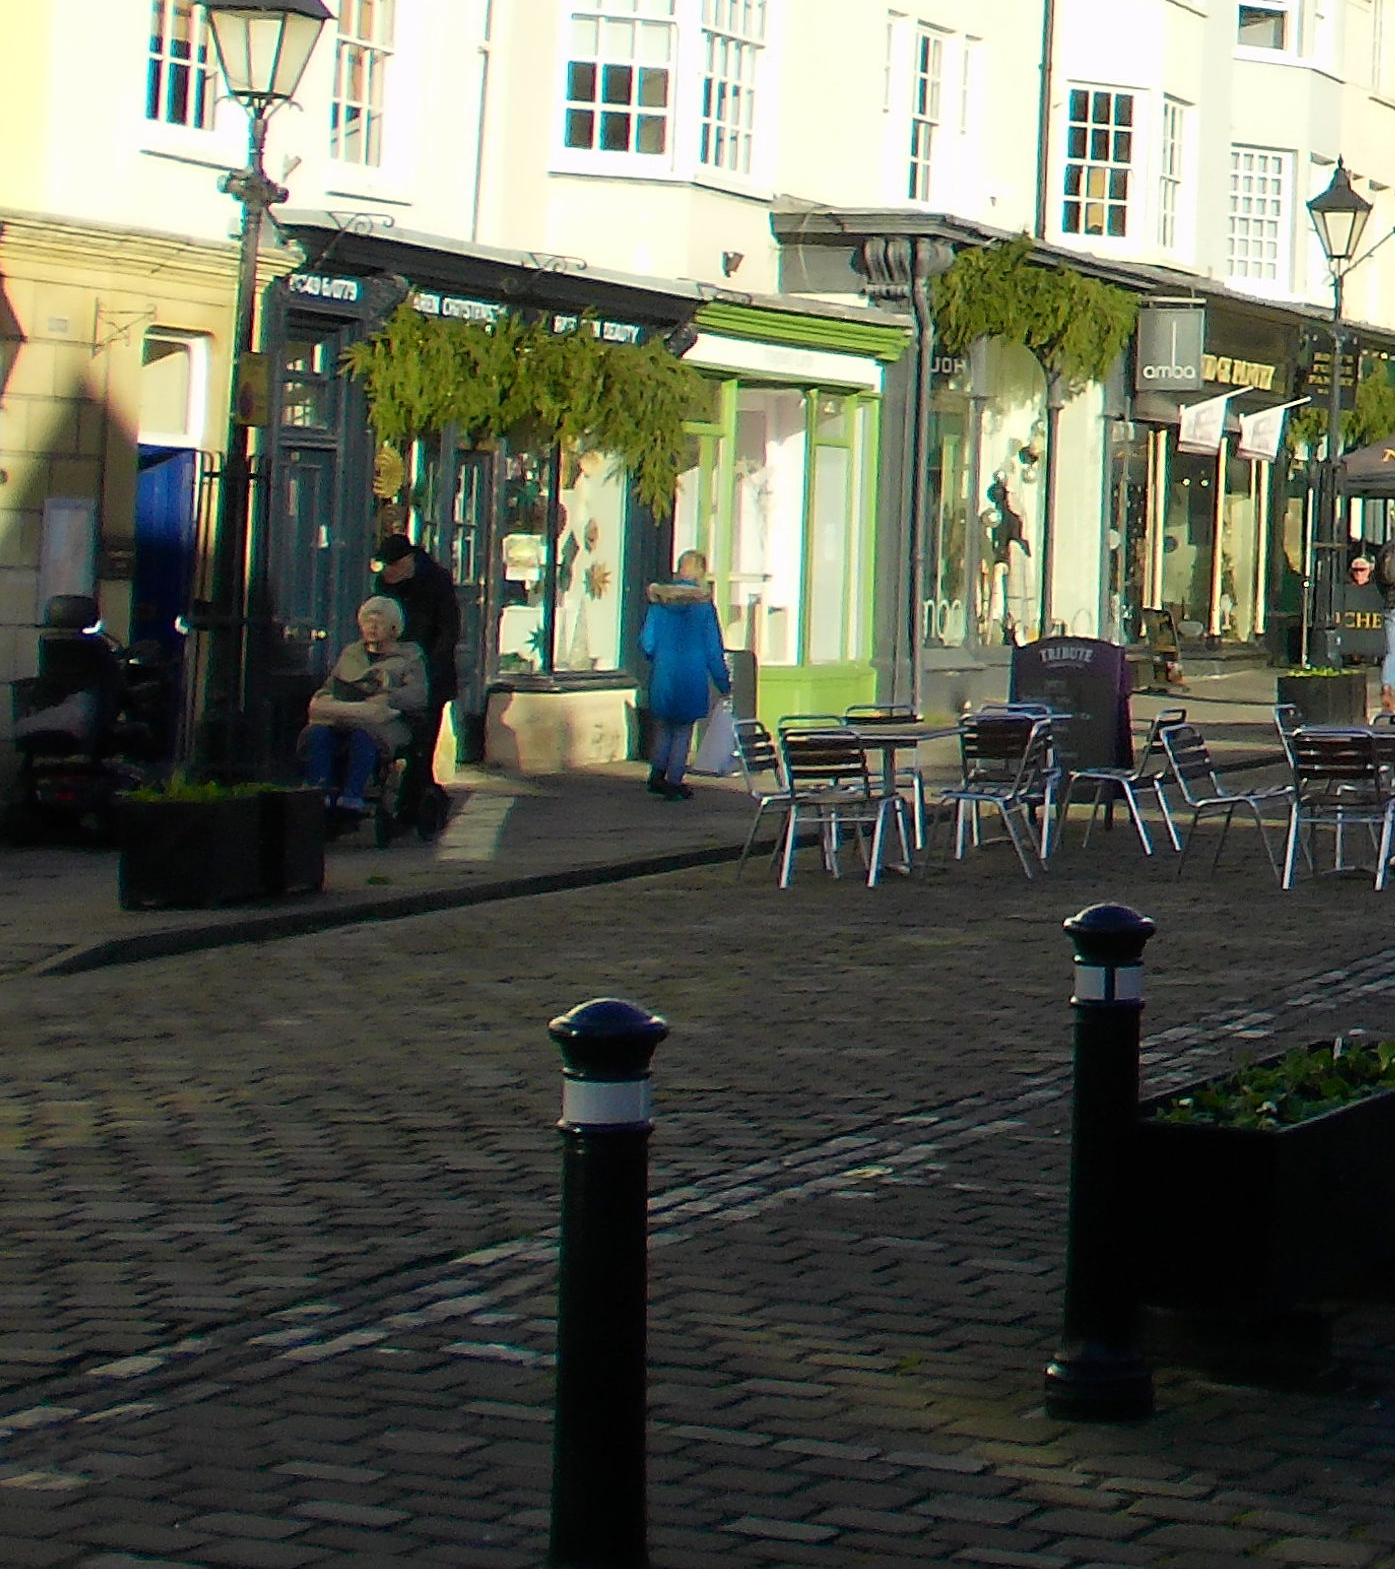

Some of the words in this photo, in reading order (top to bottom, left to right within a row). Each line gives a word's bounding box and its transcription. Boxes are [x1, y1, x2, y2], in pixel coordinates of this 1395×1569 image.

[1143, 321, 1196, 380] amba
[1334, 611, 1383, 629] ICHE
[1040, 646, 1094, 663] TRIBUTE
